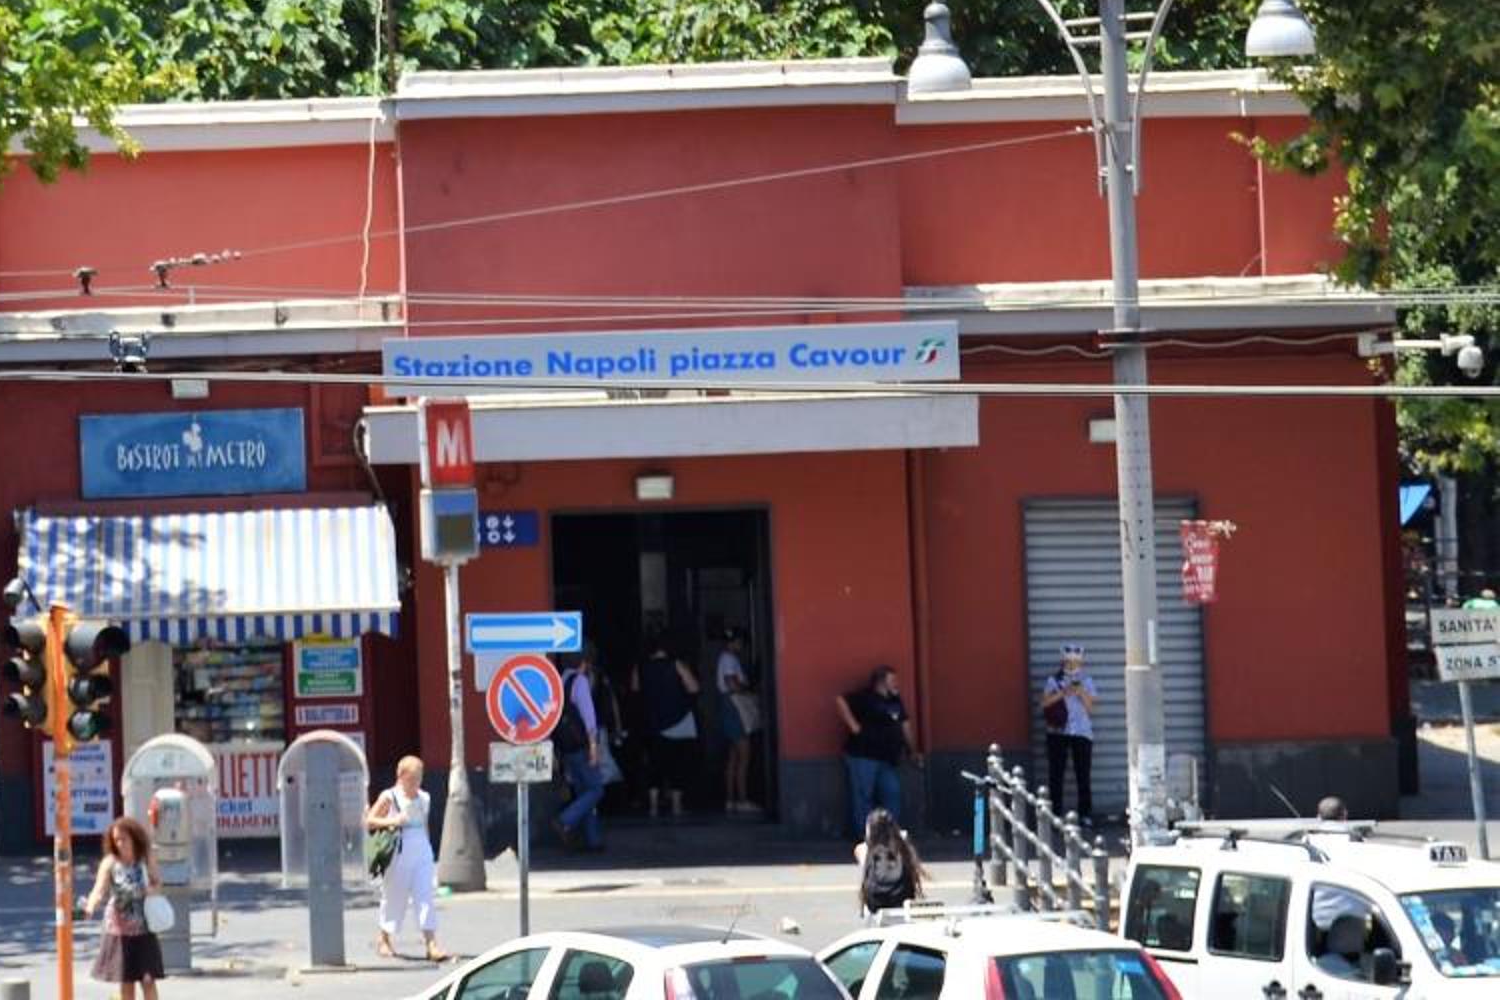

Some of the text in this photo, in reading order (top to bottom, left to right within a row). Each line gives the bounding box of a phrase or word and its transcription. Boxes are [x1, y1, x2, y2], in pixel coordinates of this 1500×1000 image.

[393, 342, 906, 379] Stazione Napoli piazza Cavour
[435, 418, 469, 468] M
[1445, 655, 1484, 671] ZONA
[1435, 846, 1467, 862] TAXI
